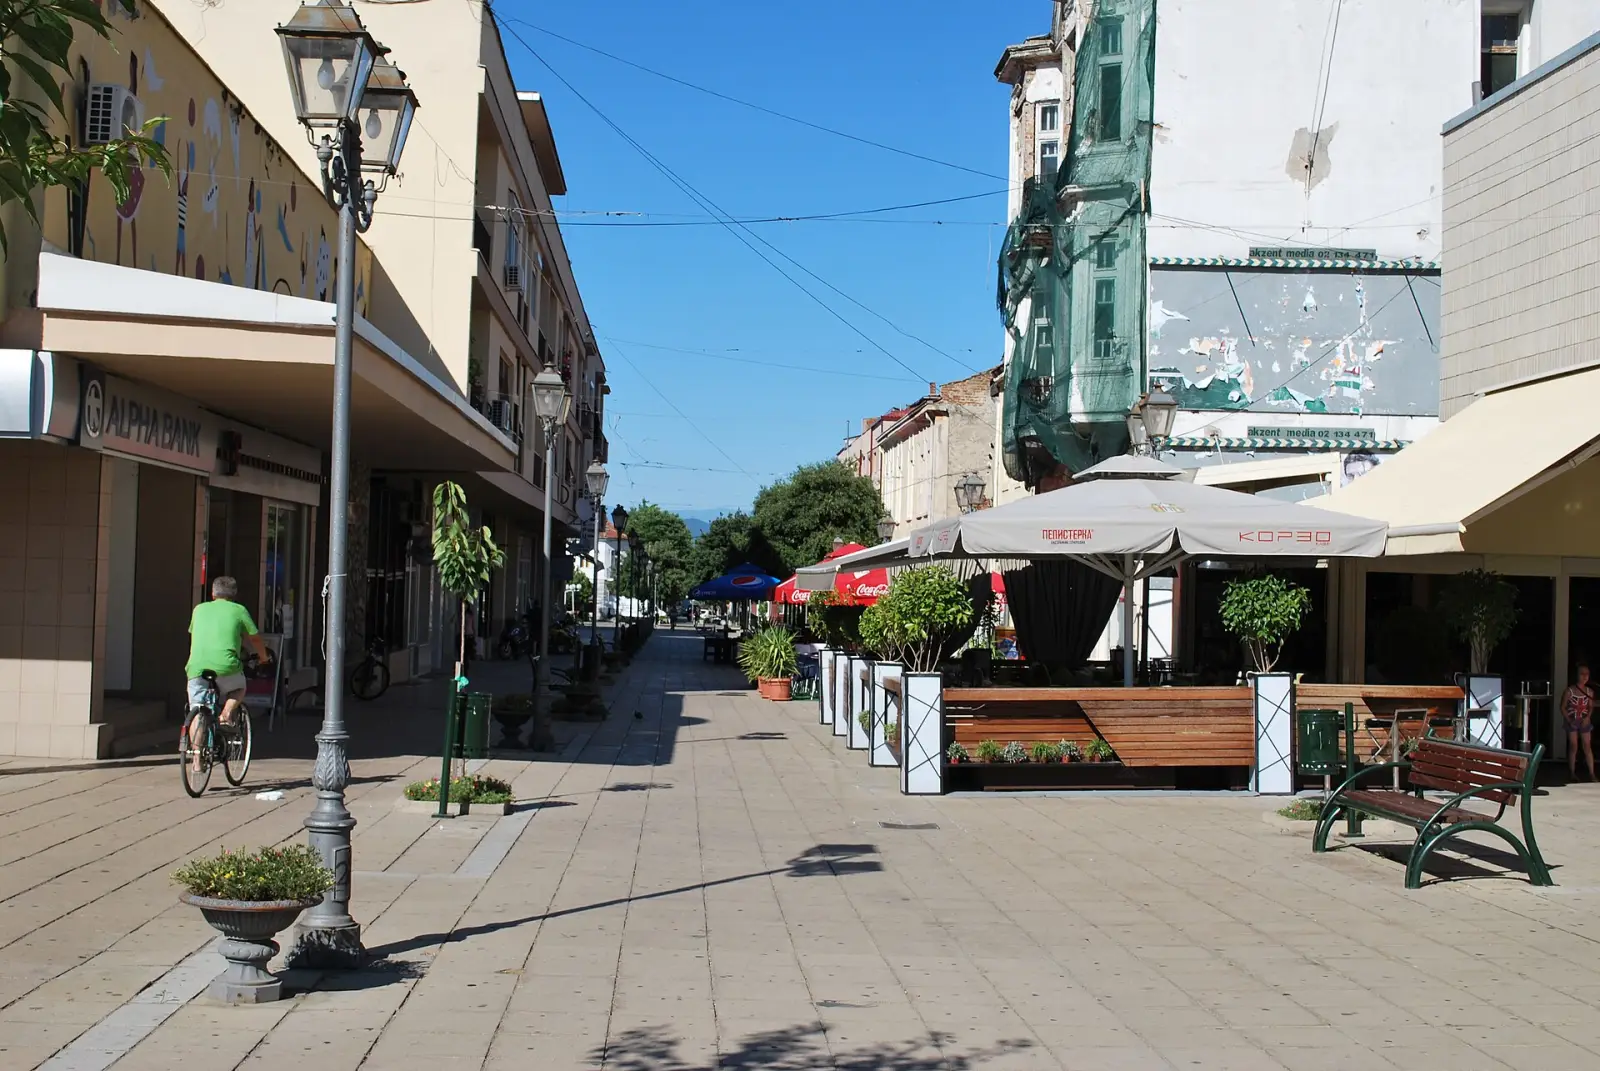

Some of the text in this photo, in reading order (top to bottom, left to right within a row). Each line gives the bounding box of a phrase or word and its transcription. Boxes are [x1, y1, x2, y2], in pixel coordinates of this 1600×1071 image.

[1249, 248, 1282, 258] akzent
[1286, 248, 1314, 258] media
[1318, 250, 1330, 258] 02
[105, 395, 202, 458] ALPHA BANK
[1248, 427, 1281, 438] akzent
[1286, 428, 1315, 438] media
[1318, 430, 1329, 438] 02
